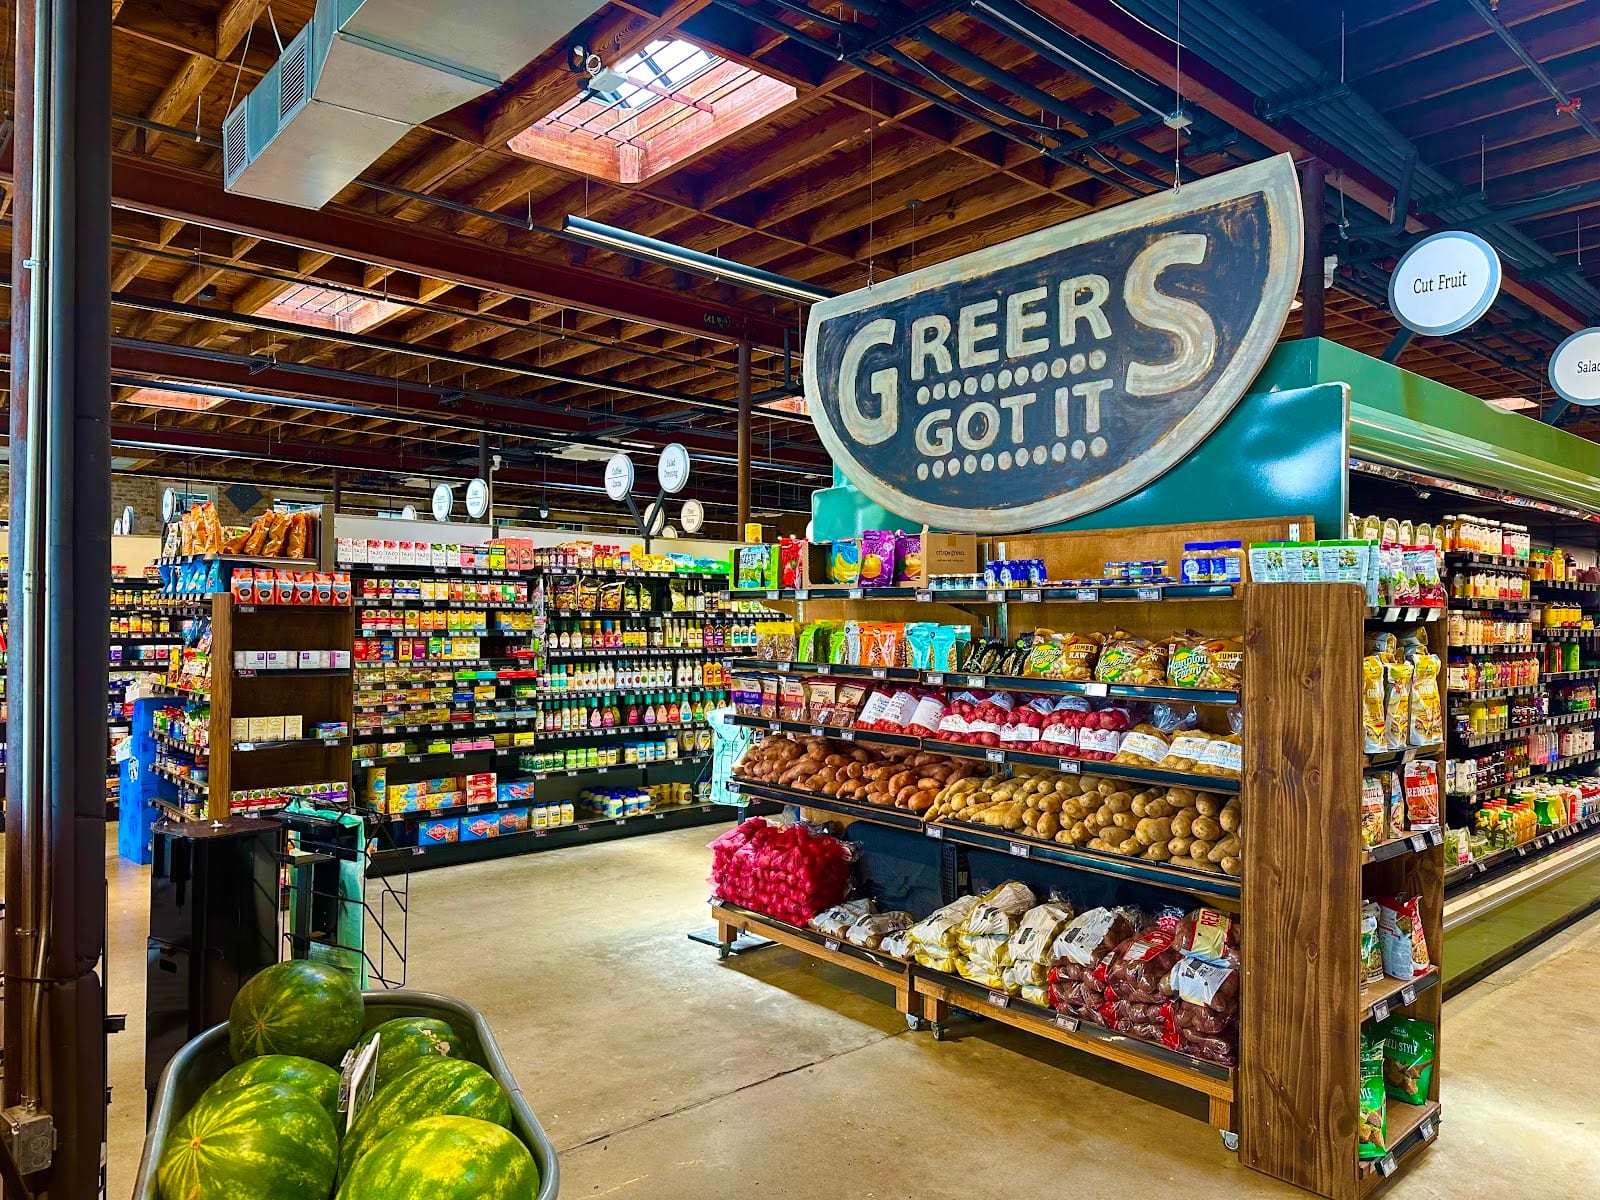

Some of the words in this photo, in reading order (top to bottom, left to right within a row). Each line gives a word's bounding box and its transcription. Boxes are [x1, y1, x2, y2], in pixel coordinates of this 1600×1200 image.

[1413, 278, 1434, 294] Cut
[1438, 270, 1468, 290] Fruit
[838, 232, 1218, 447] GREERS
[914, 394, 1037, 457] GOT
[1054, 378, 1114, 438] IT
[1069, 652, 1088, 660] RAW
[1073, 643, 1094, 652] JUMBO
[1167, 651, 1207, 677] Hampton
[1173, 662, 1206, 686] Farms
[1201, 910, 1220, 927] RED
[1384, 1038, 1418, 1056] DELI-STYLE
